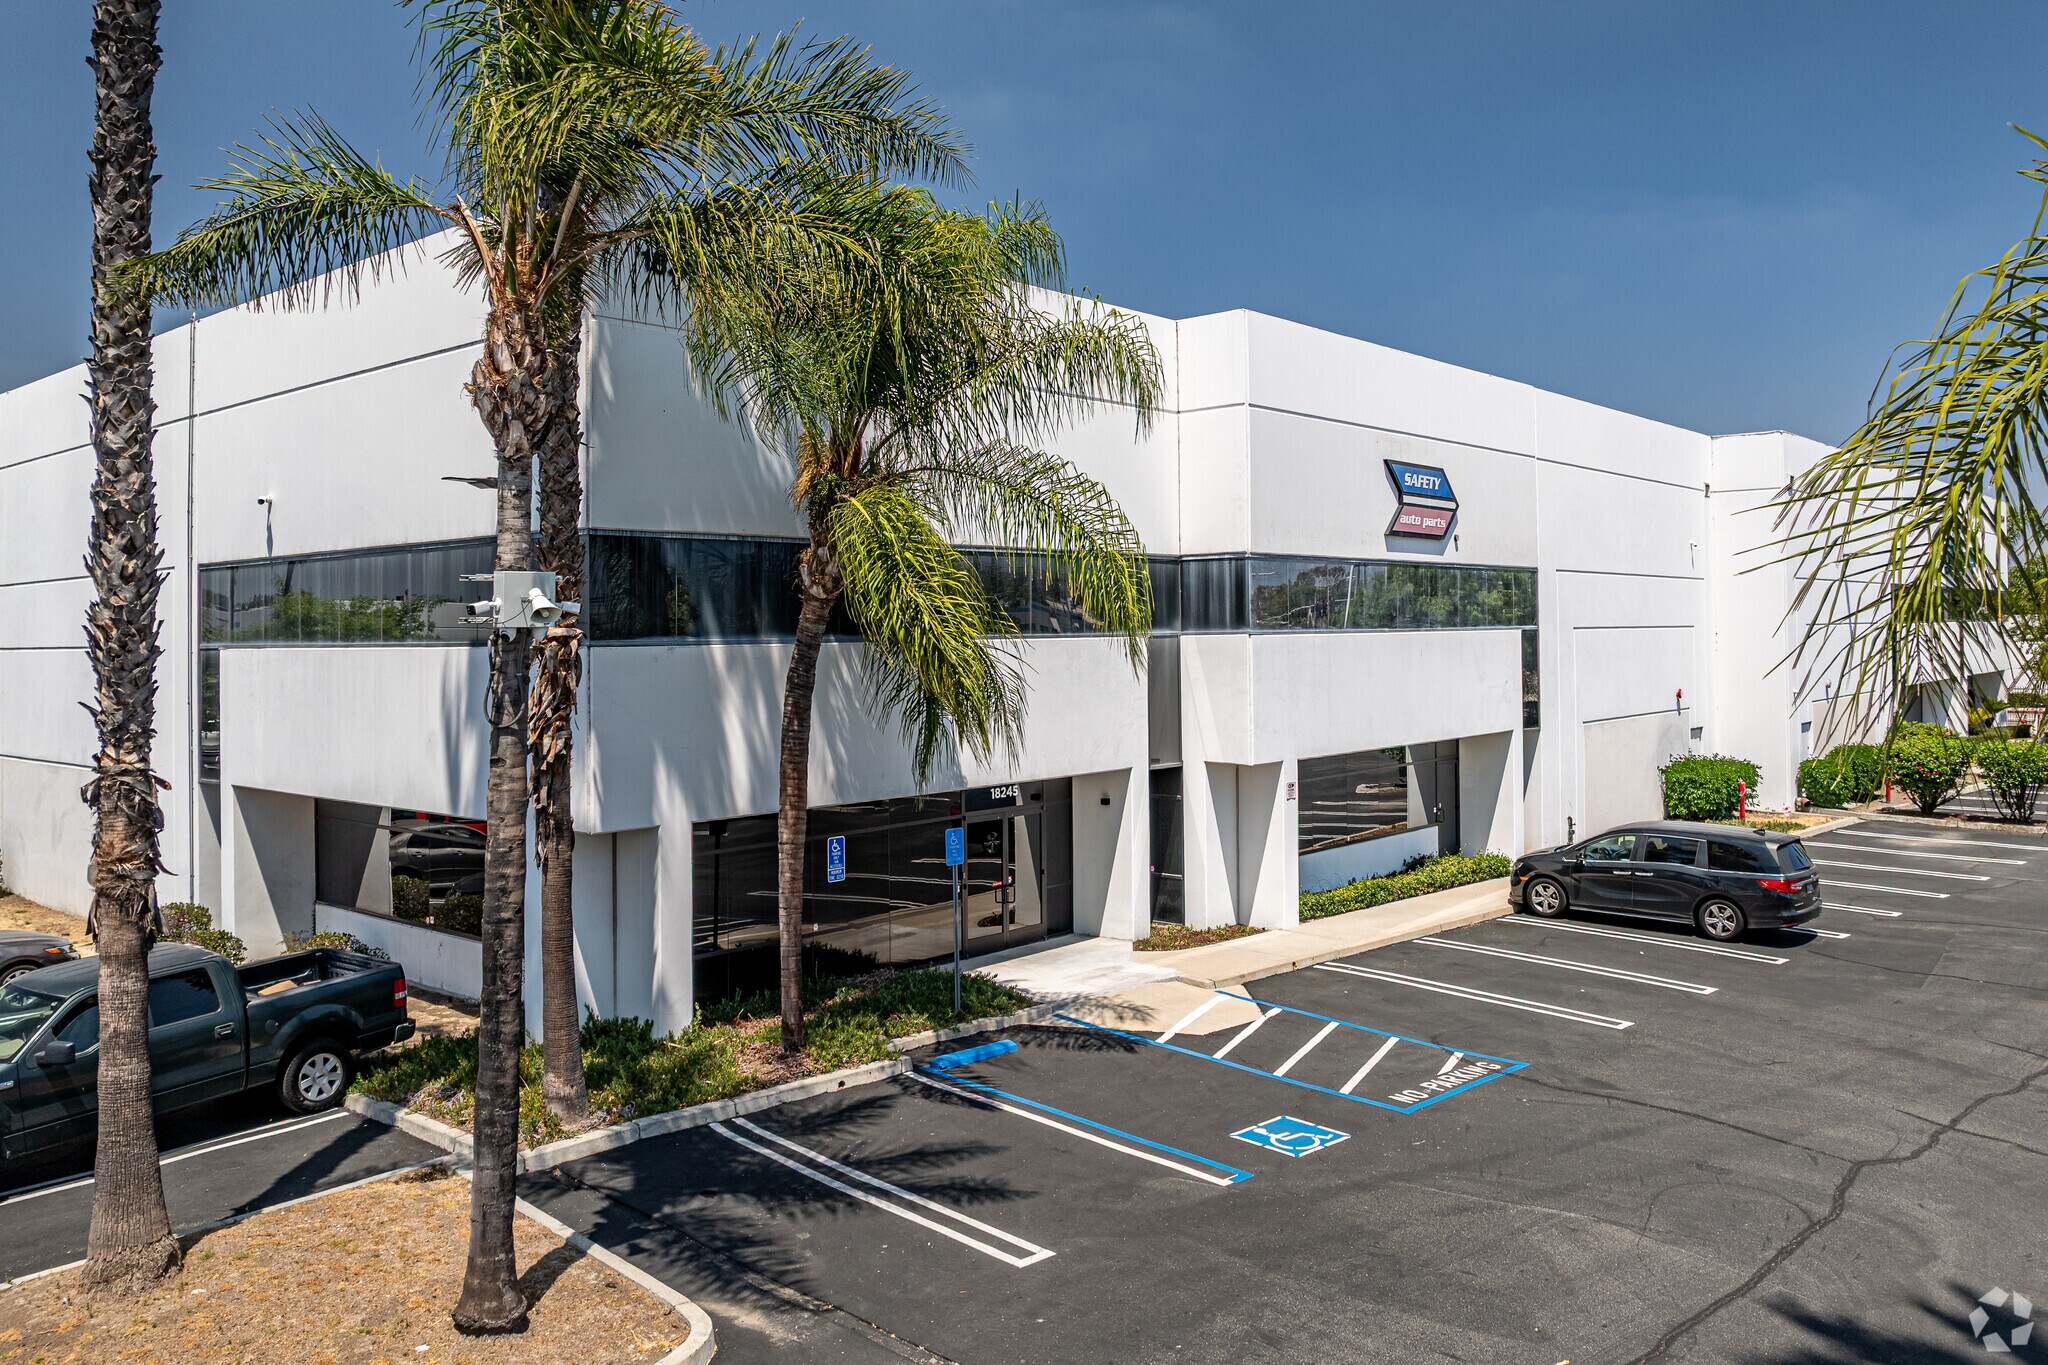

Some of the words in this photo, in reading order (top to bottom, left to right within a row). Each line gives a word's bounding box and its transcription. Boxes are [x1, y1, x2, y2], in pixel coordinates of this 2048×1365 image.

[1404, 472, 1442, 490] SAFETY
[1400, 514, 1421, 525] auto
[1422, 516, 1446, 529] parts
[990, 785, 1019, 800] 18245
[1388, 1089, 1429, 1104] NO
[1419, 1061, 1502, 1092] PARKING
